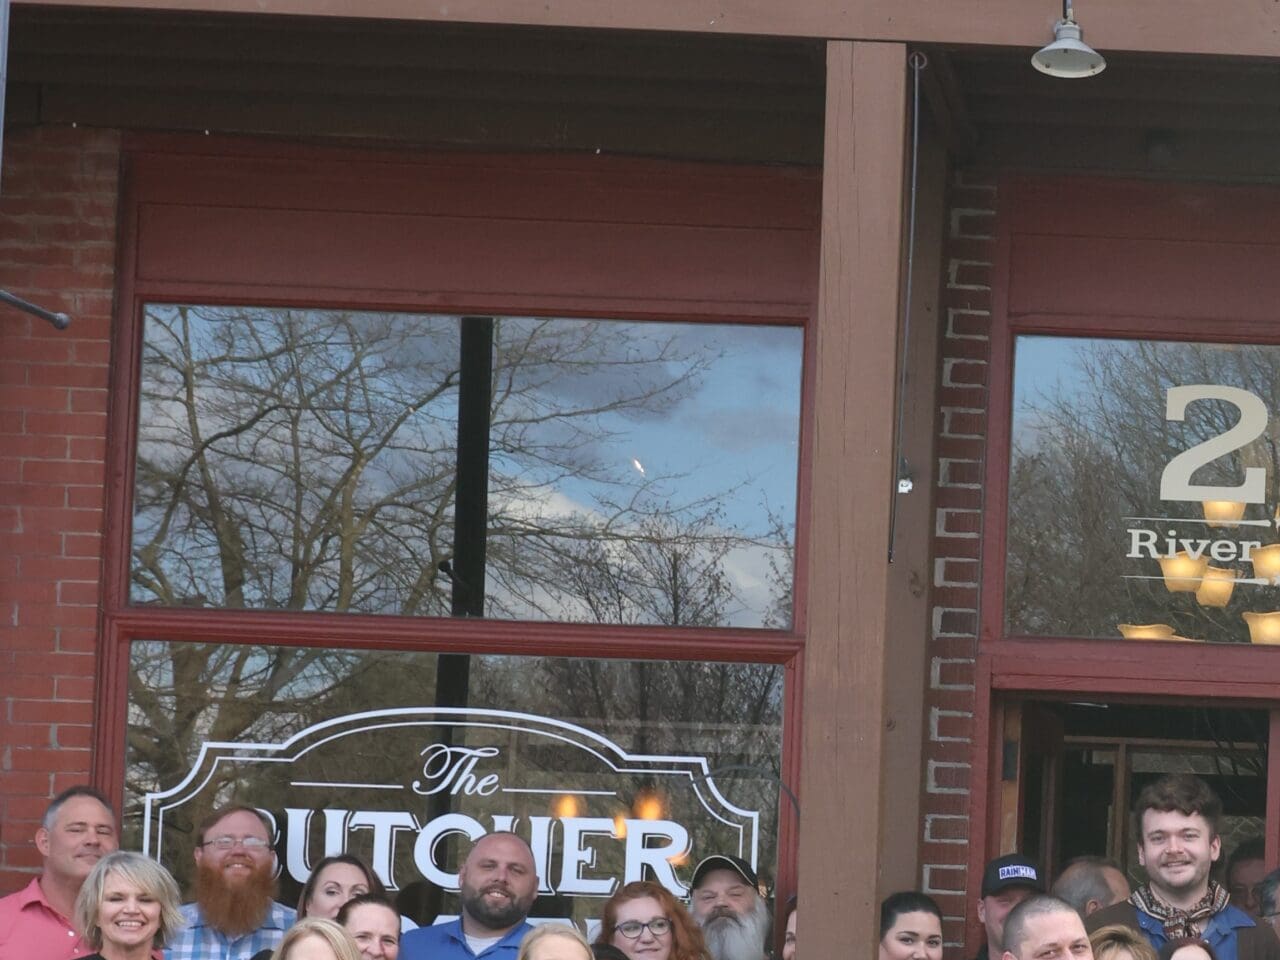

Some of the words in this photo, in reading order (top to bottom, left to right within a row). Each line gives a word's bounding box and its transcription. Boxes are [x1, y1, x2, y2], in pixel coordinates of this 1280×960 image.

[1126, 528, 1262, 563] River
[412, 742, 500, 798] The
[254, 807, 692, 902] UTCHER
